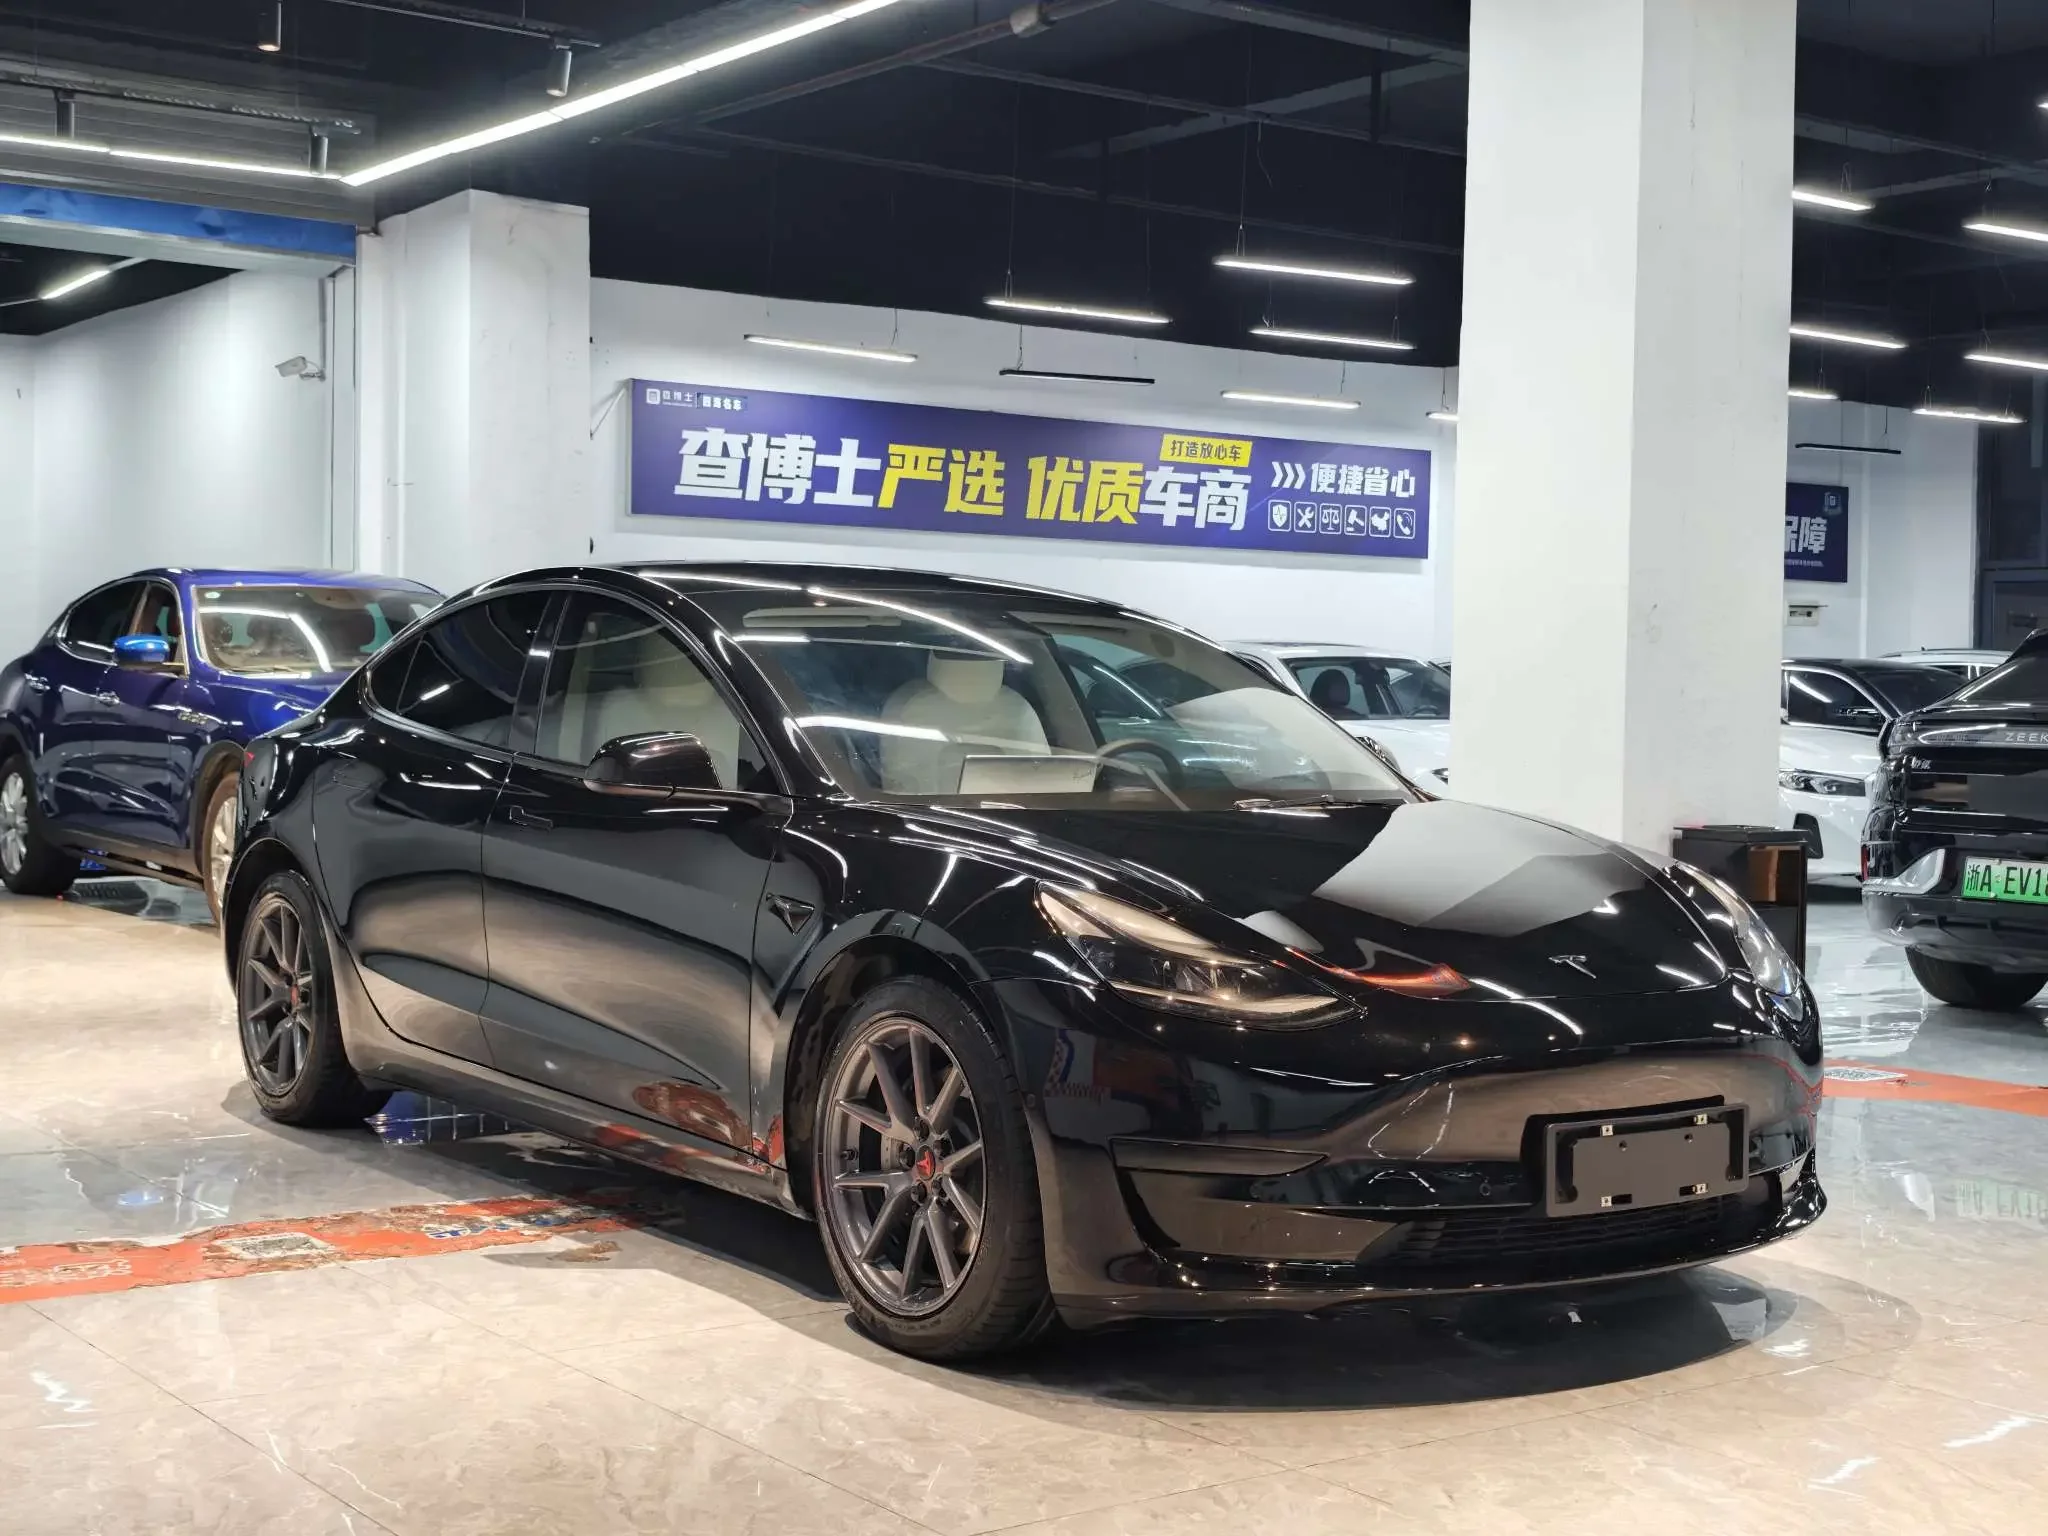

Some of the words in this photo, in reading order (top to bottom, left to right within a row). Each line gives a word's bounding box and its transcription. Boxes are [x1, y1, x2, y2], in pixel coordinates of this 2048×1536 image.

[1170, 439, 1242, 461] 打造放心车
[674, 427, 1005, 516] 查博士严选
[1026, 456, 1252, 531] 优质车商
[1311, 462, 1416, 498] 便捷省心
